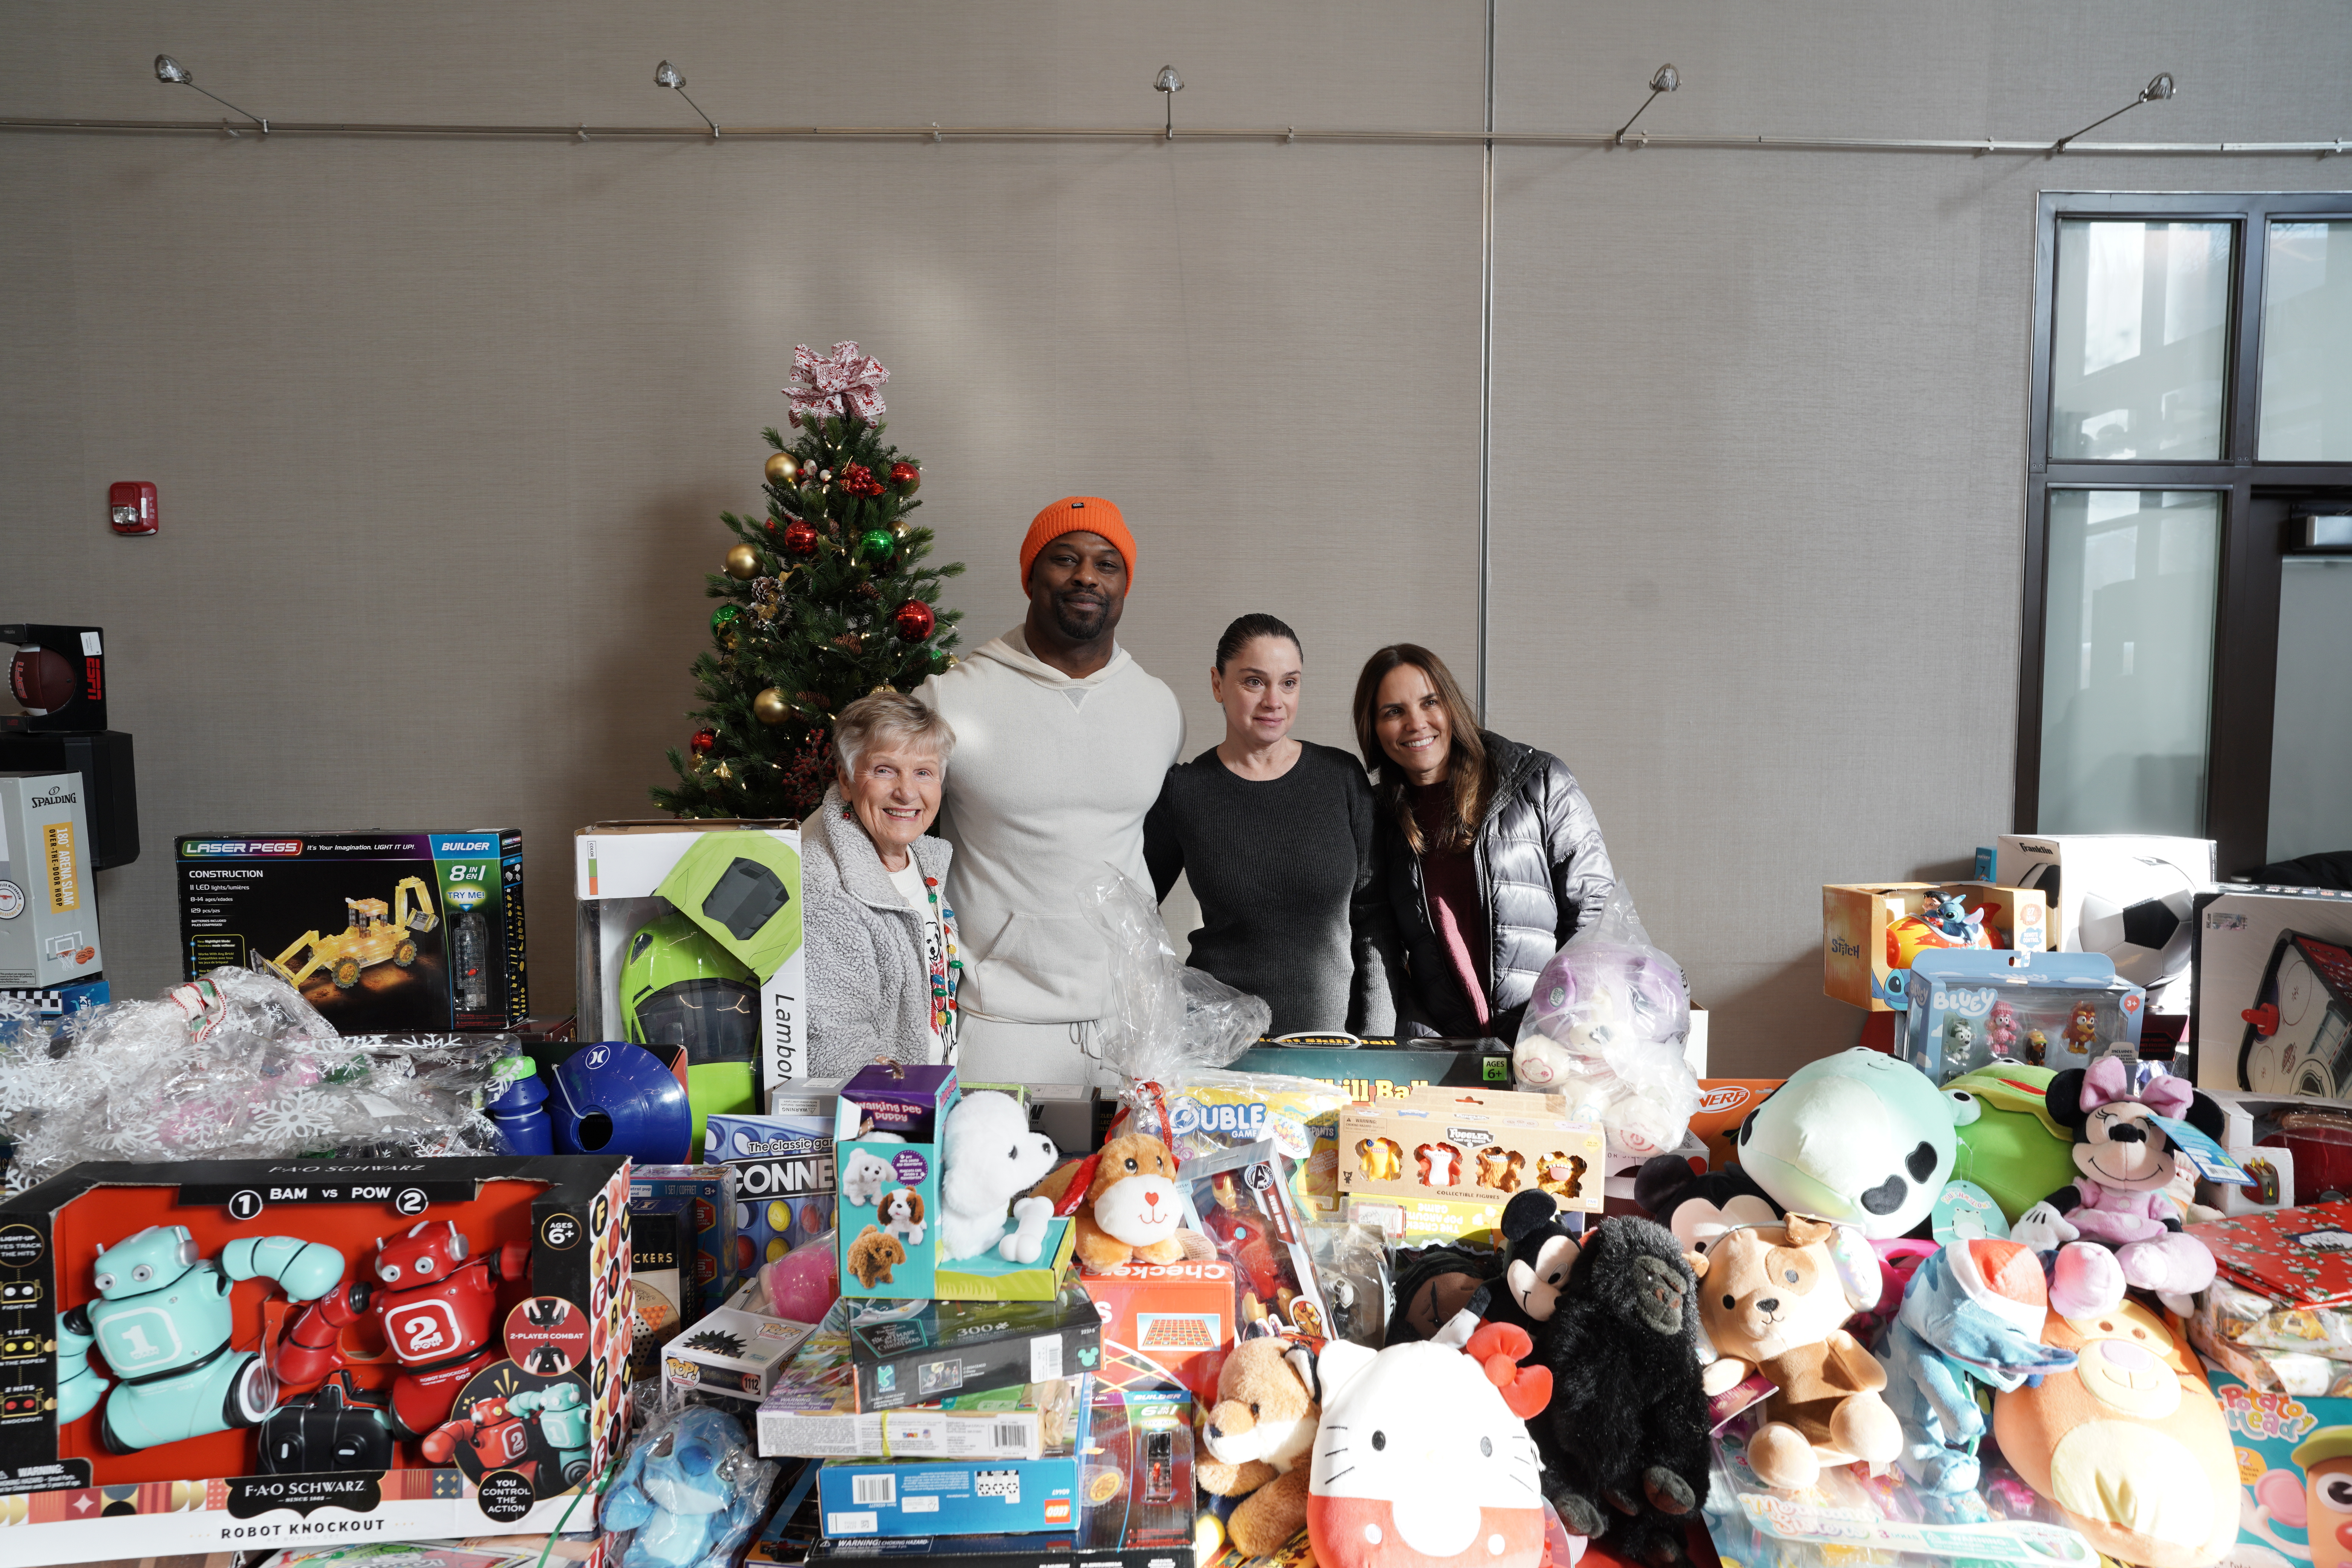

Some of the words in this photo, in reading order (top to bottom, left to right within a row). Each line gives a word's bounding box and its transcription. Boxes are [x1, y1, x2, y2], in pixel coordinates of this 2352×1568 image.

[15, 661, 28, 699] ESPN
[86, 657, 101, 700] ESPN
[31, 792, 77, 808] SPALDING
[187, 844, 246, 853] LASER
[250, 843, 297, 852] PEGS
[441, 842, 490, 851] BUILDER
[2019, 842, 2054, 855] Franklin
[49, 829, 60, 886] OVER-THE-DOOR
[59, 851, 72, 880] ARENA
[449, 865, 467, 881] 8
[8, 884, 22, 900] MECHANISM
[1487, 1069, 1502, 1078] 6+
[1449, 1128, 1492, 1142] FUGGLER
[749, 1141, 769, 1154] The
[771, 1137, 812, 1152] classic
[270, 1188, 308, 1199] BAM
[352, 1187, 391, 1198] POW
[679, 1185, 697, 1195] COFFRET
[238, 1195, 251, 1214] 1
[403, 1193, 421, 1211] 2
[548, 1229, 575, 1244] 6+
[957, 1323, 993, 1337] 300
[666, 1357, 700, 1381] POP!
[455, 1372, 471, 1381] 002
[672, 1377, 694, 1386] ANIMATION
[744, 1377, 759, 1391] 1112
[1141, 1406, 1154, 1416] 6
[288, 1480, 365, 1494] SCHWARZ
[487, 1505, 525, 1513] ACTION
[1046, 1505, 1069, 1517] LEGO
[221, 1525, 282, 1539] ROBOT
[289, 1519, 385, 1534] KNOCKOUT
